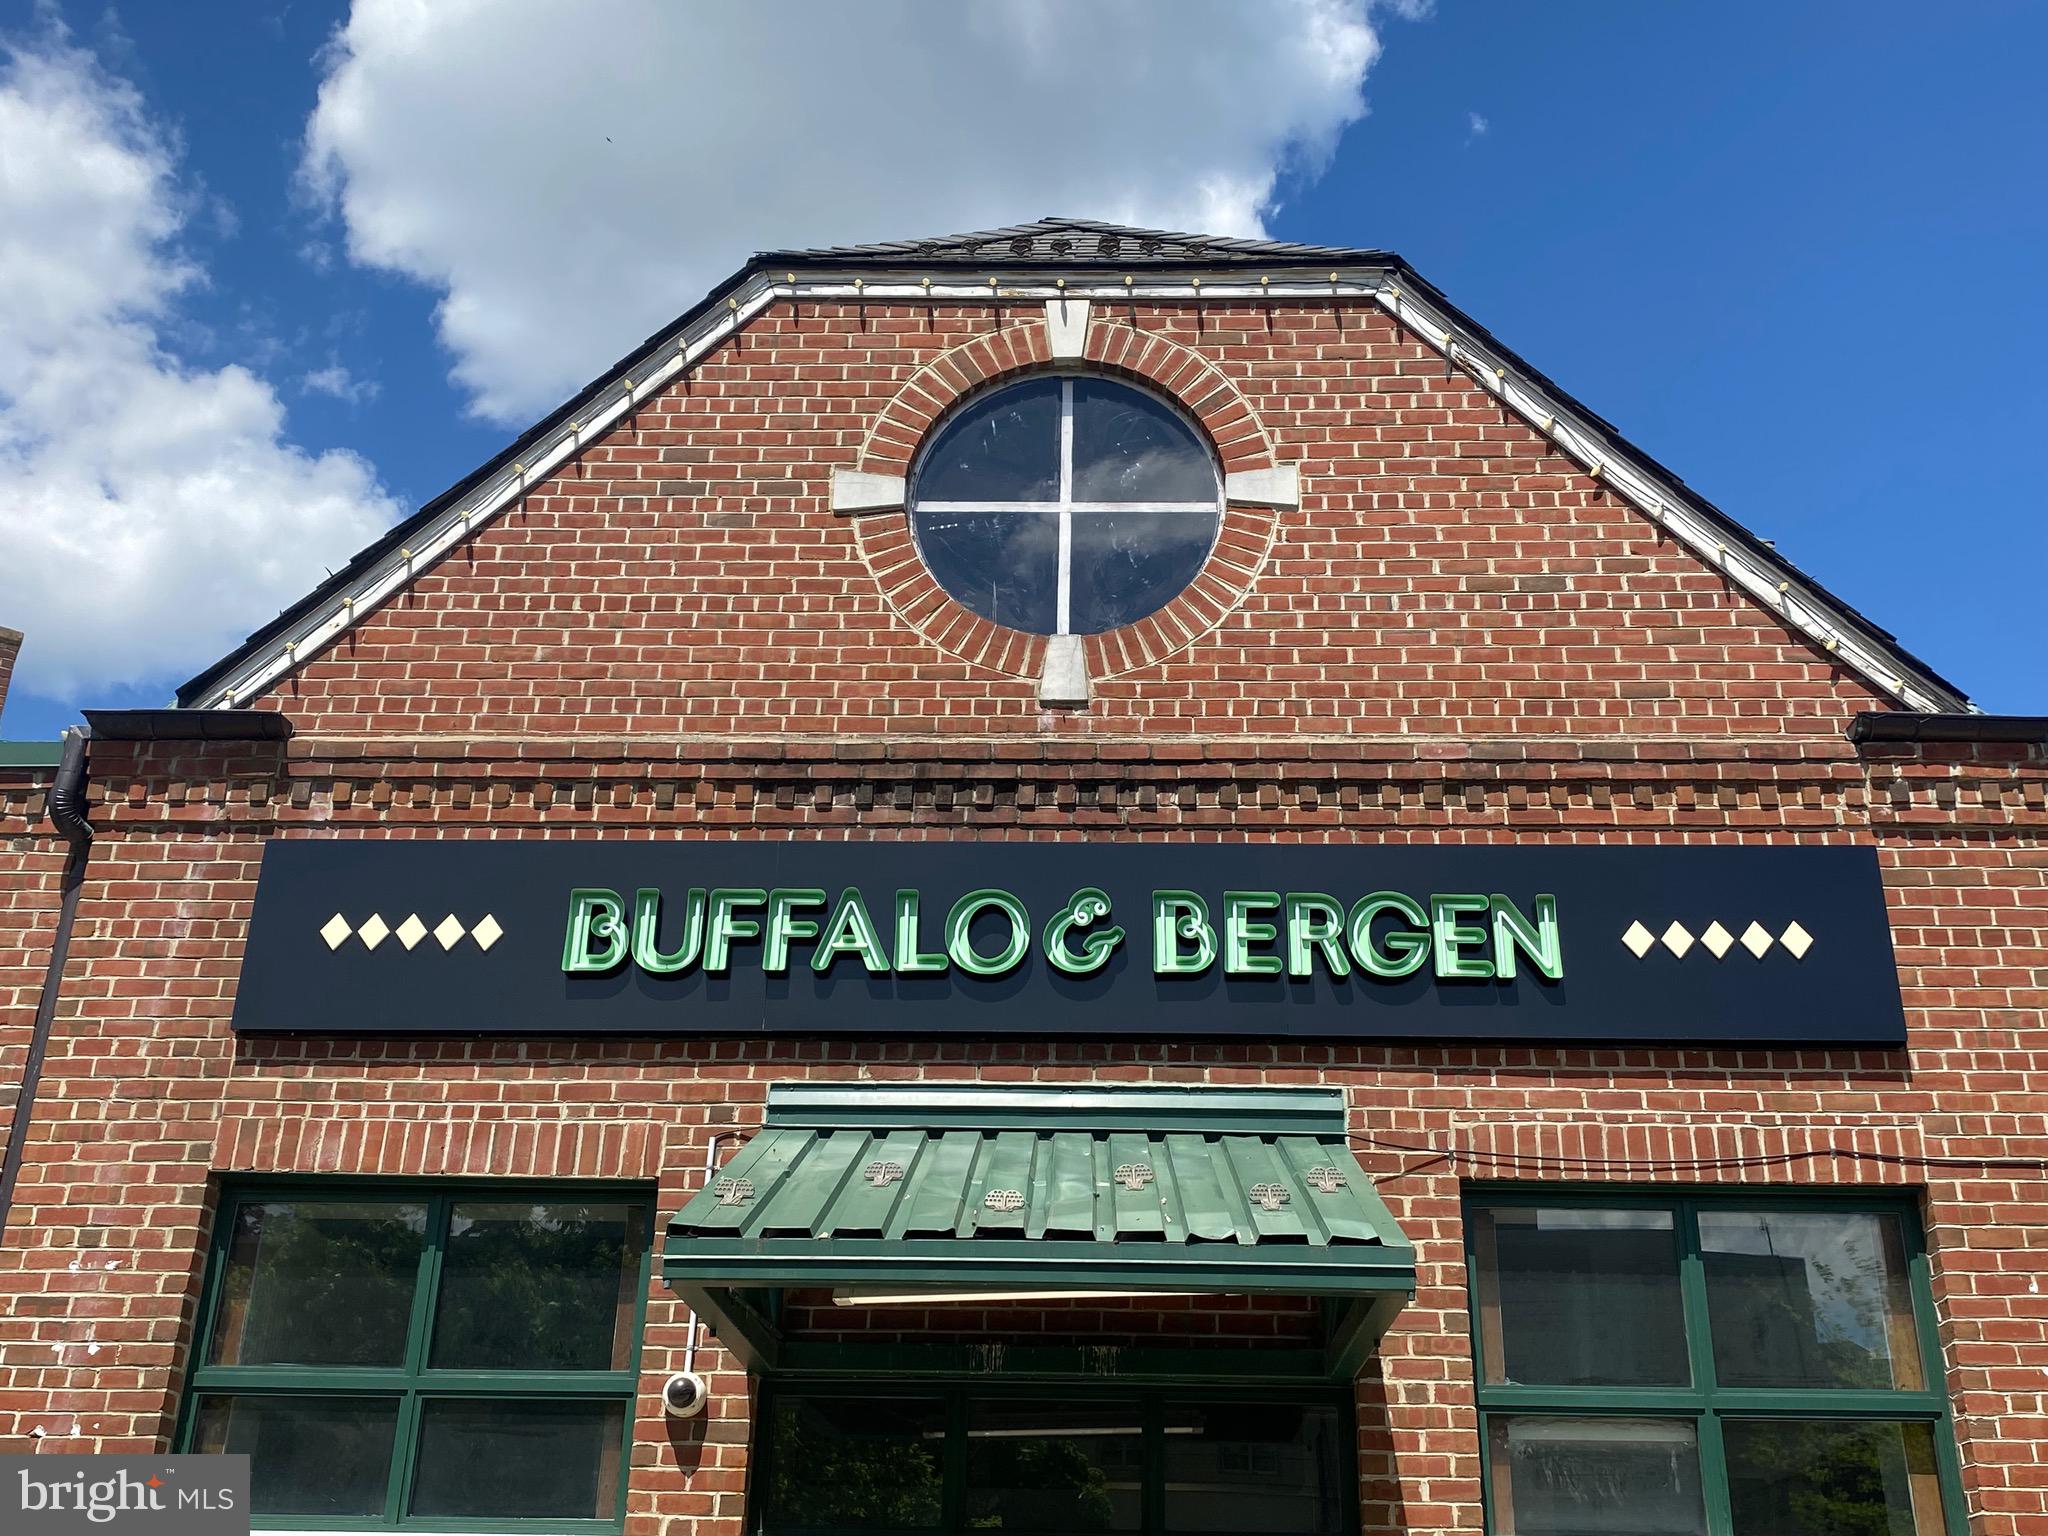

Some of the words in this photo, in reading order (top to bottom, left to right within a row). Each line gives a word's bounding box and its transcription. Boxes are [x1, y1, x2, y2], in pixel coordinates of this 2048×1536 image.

[561, 886, 1031, 976] BUFFALO
[1042, 886, 1126, 975] &
[1152, 888, 1564, 979] BERGEN
